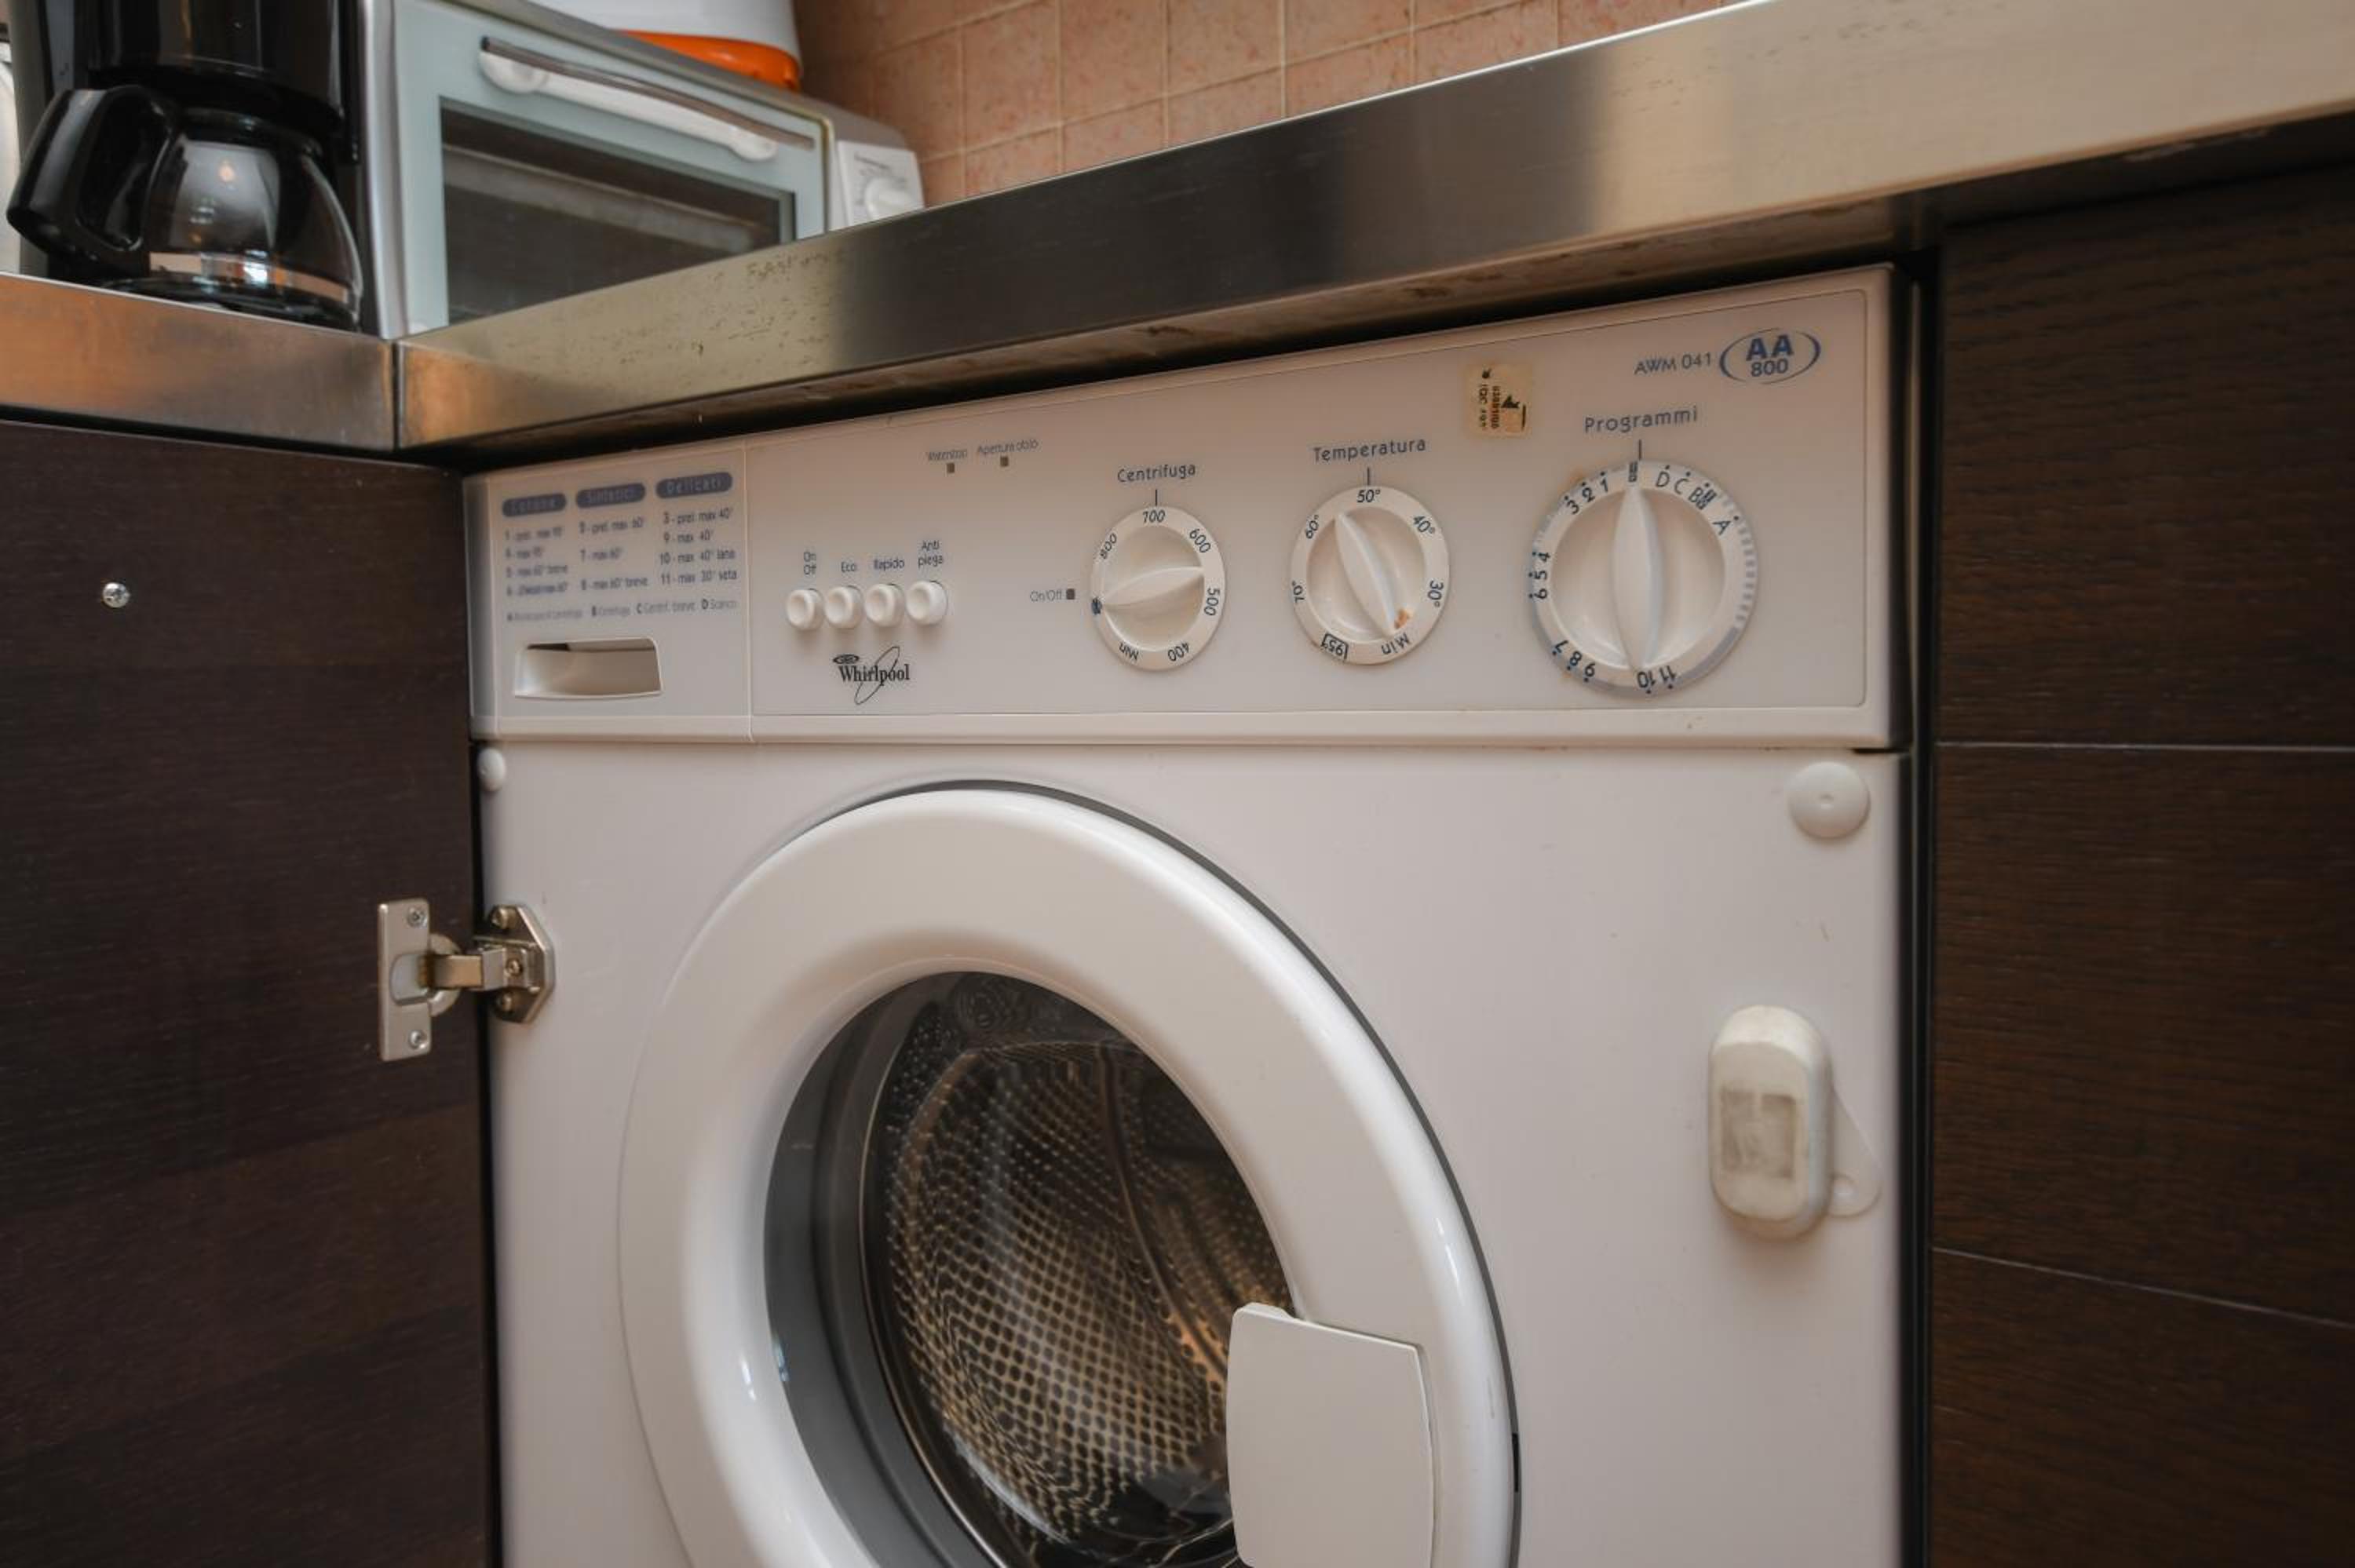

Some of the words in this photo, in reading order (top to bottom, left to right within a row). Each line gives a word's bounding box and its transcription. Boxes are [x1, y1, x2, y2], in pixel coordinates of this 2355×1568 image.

[1746, 334, 1794, 362] AA
[1634, 357, 1678, 374] AWM
[1681, 351, 1712, 370] 041
[1750, 359, 1789, 377] 800
[1583, 406, 1698, 433] Programmi
[1313, 439, 1426, 463] Temperatura
[1116, 463, 1196, 483] Centrifuga
[1656, 471, 1670, 487] D
[1601, 479, 1609, 493] 1
[1674, 478, 1689, 494] C
[1581, 487, 1596, 503] 2
[1566, 500, 1580, 515] 3
[699, 511, 716, 521] max
[1142, 509, 1167, 523] 700
[1713, 520, 1732, 535] A
[677, 533, 694, 543] max
[922, 539, 940, 551] Anti
[1189, 527, 1211, 554] 600
[1099, 533, 1118, 560] 800
[659, 552, 670, 565] 10
[677, 553, 694, 563] max
[803, 551, 816, 562] On
[918, 553, 944, 569] piega
[1539, 550, 1551, 563] 4
[841, 561, 856, 572] Eco
[661, 574, 670, 585] 11
[1535, 569, 1547, 582] 5
[1203, 587, 1221, 616] 500
[1534, 589, 1548, 599] 6
[701, 598, 708, 610] D
[1167, 640, 1190, 662] 400
[1381, 633, 1411, 655] Min
[1554, 639, 1568, 654] 7
[1569, 651, 1582, 668] 8
[838, 664, 911, 687] Whirlpool
[1584, 662, 1596, 678] 9
[1636, 670, 1656, 689] 10
